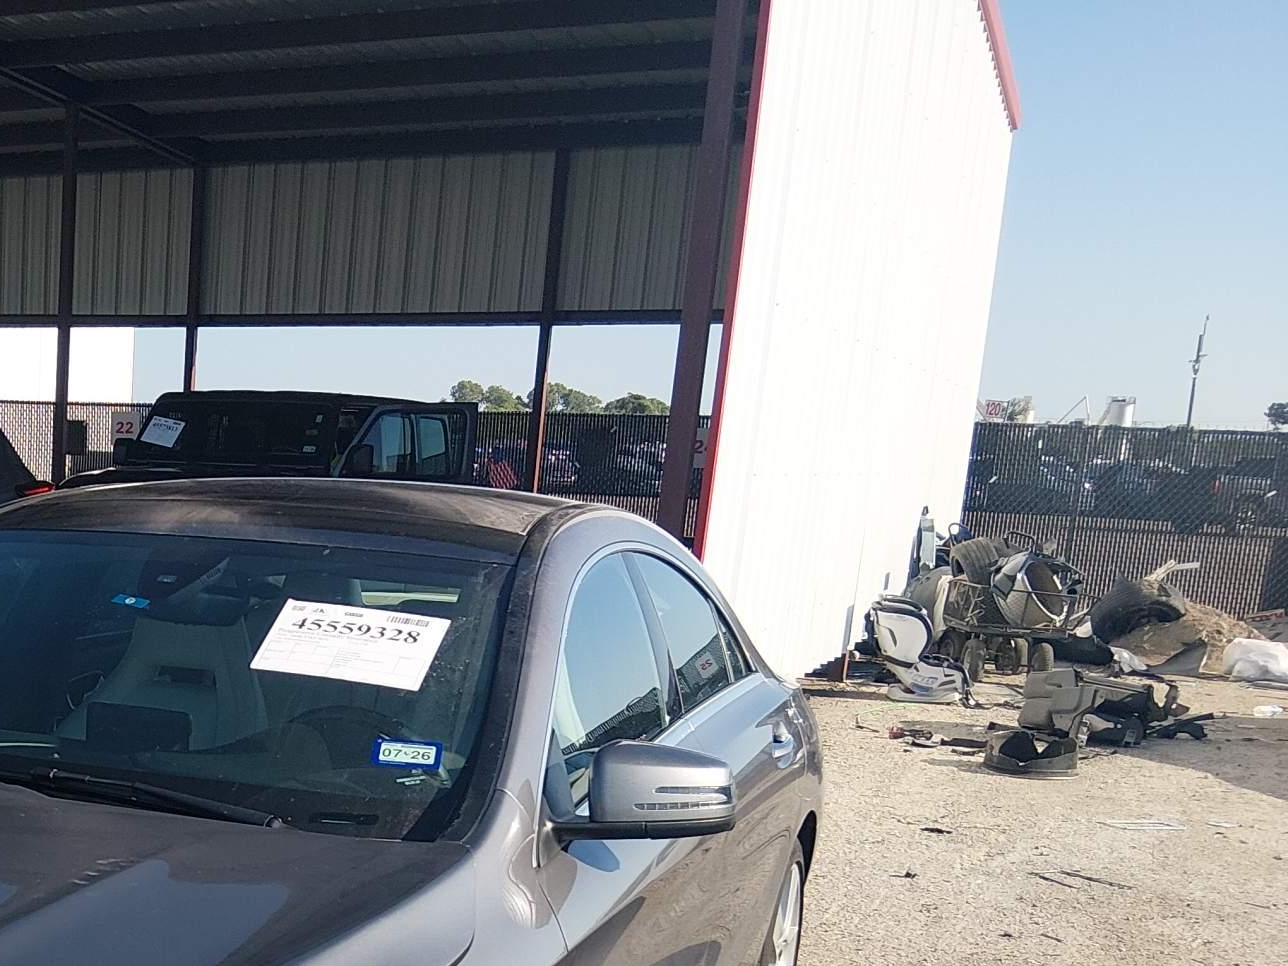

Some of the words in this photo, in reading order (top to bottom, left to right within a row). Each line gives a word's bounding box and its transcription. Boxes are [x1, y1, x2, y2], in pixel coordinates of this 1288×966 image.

[985, 402, 1001, 416] 120
[115, 421, 134, 434] 22
[291, 617, 421, 644] 45559328
